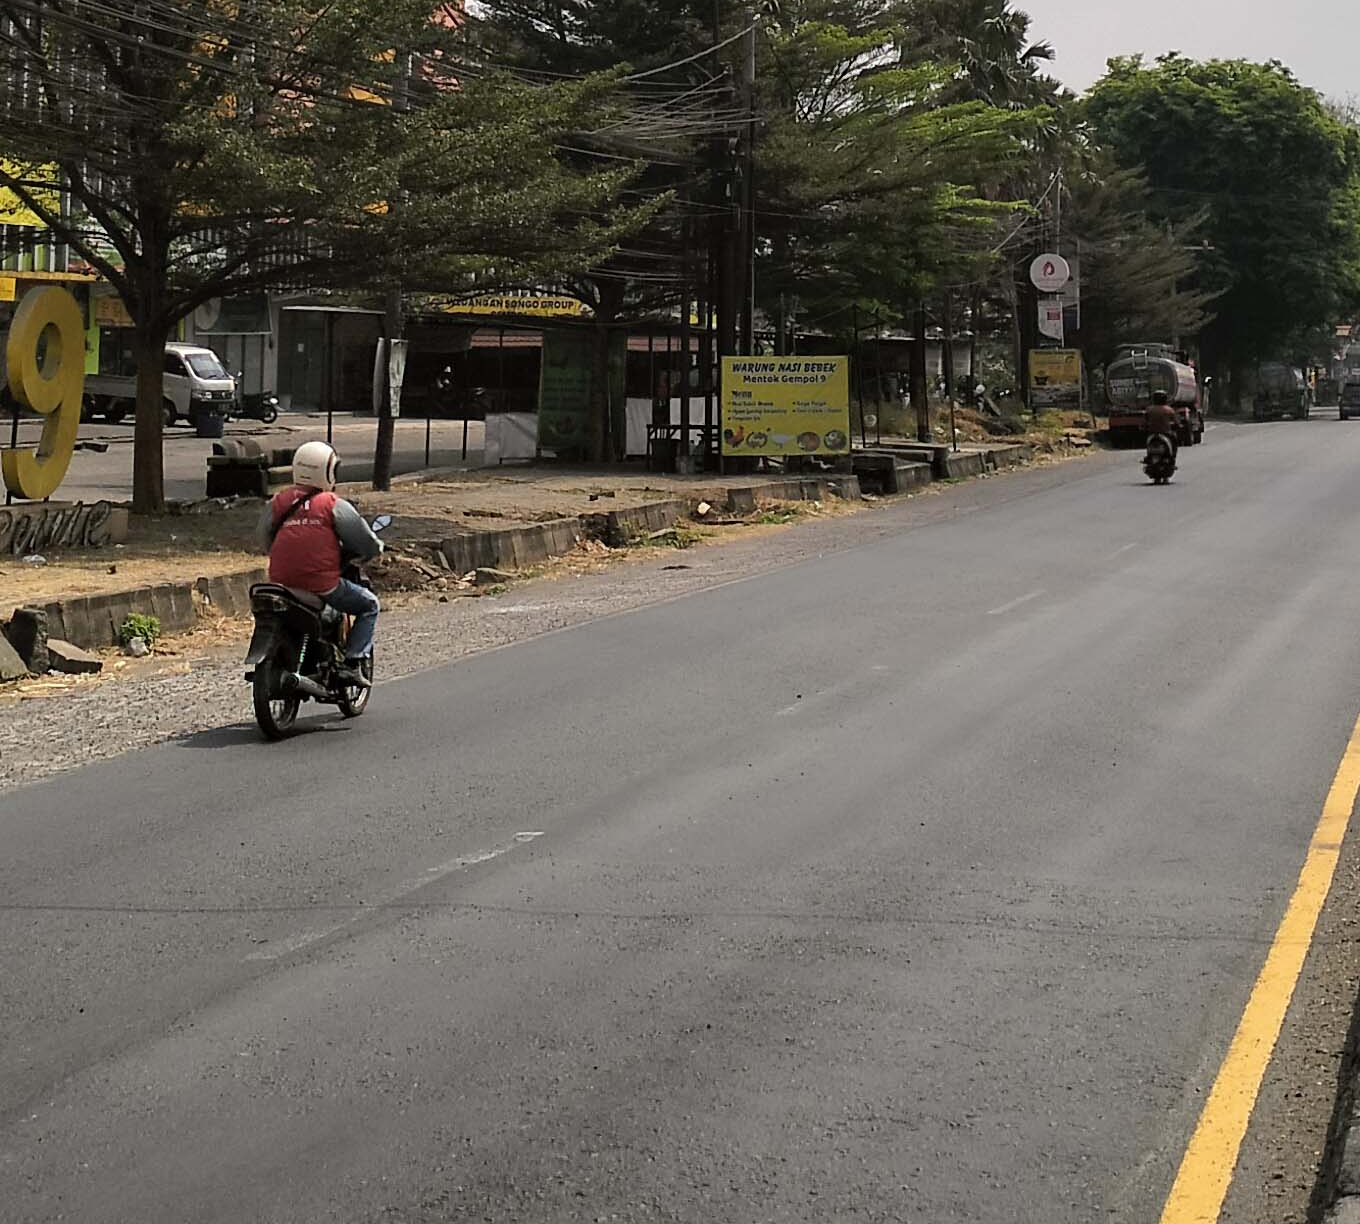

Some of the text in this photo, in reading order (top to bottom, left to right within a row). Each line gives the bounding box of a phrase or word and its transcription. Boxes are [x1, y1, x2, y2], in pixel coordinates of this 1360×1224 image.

[505, 299, 540, 309] SONGO
[541, 300, 574, 310] GROUP
[732, 362, 837, 373] WARUNG NASI BEBEK
[743, 375, 827, 384] Mentok Gempol 9
[1, 285, 85, 500] 9
